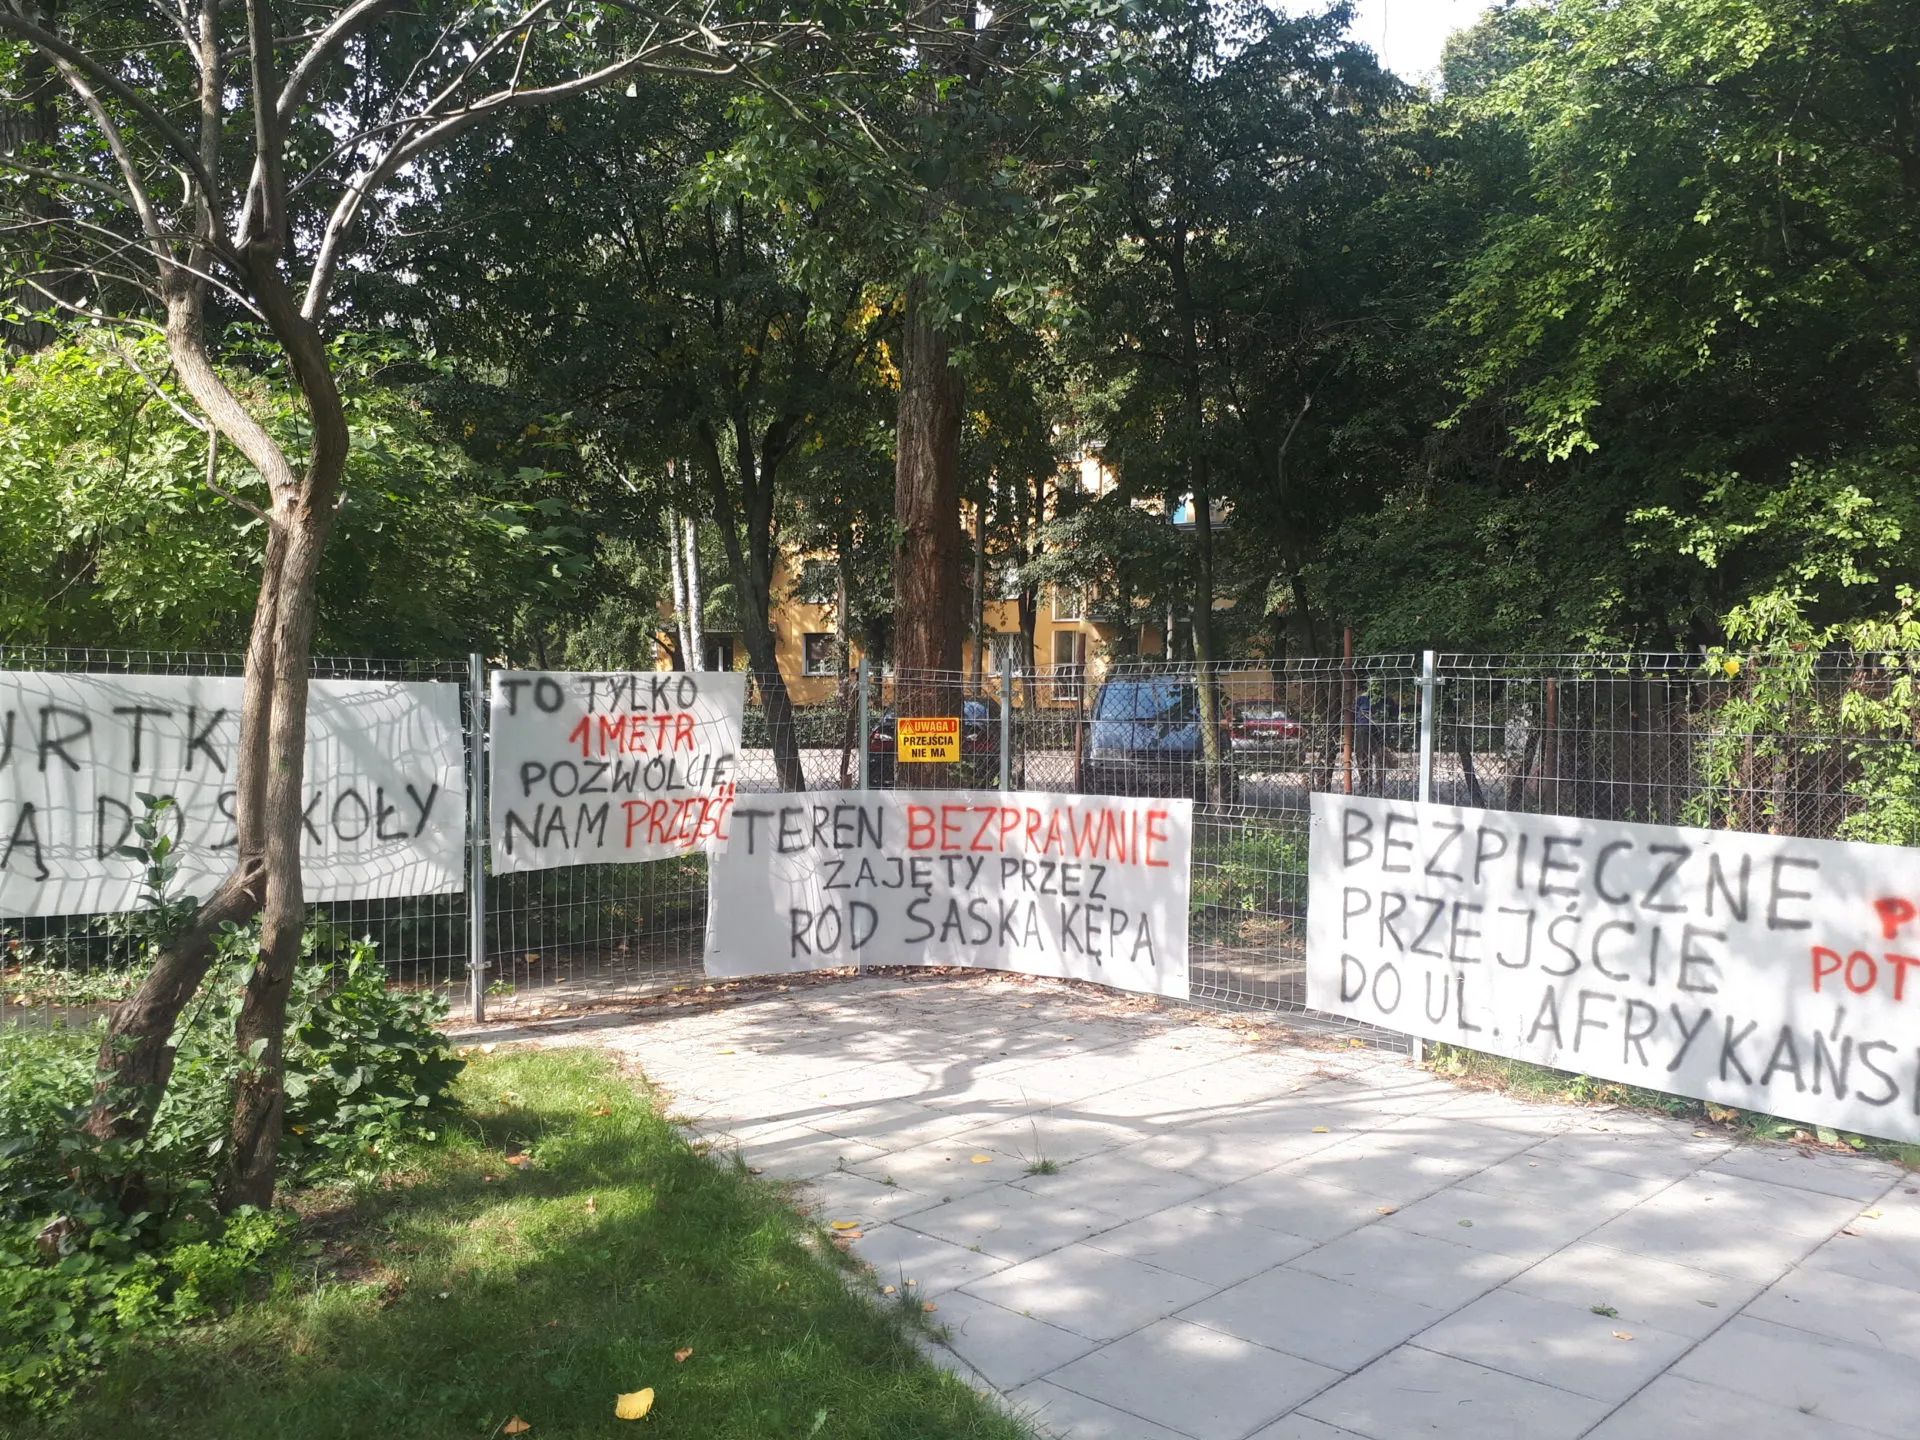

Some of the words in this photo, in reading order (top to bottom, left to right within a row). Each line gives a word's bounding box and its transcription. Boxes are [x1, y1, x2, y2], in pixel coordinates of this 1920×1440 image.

[500, 676, 565, 716] TO
[579, 674, 699, 714] TYLKO
[903, 733, 954, 746] PRZEJŚCIA
[912, 748, 927, 757] NIE
[931, 748, 946, 757] MA
[520, 753, 734, 798] POZWÓLCIE
[97, 795, 185, 861] DO
[504, 801, 610, 855] NAM
[732, 801, 883, 855] TEREN
[906, 804, 1170, 868] BEZPRAWNIE
[822, 855, 985, 896] ZAJĘTY
[1000, 861, 1107, 901] PRZEZ
[1341, 808, 1820, 931] BEZPIECZNE
[790, 900, 879, 959] ROD
[904, 897, 1045, 952] SASKA
[1061, 900, 1156, 968] KĘPA
[1342, 886, 1728, 995] PRZEJŚCIE
[1340, 953, 1402, 1015] DO
[1526, 983, 1920, 1119] AFRYKAŃS
